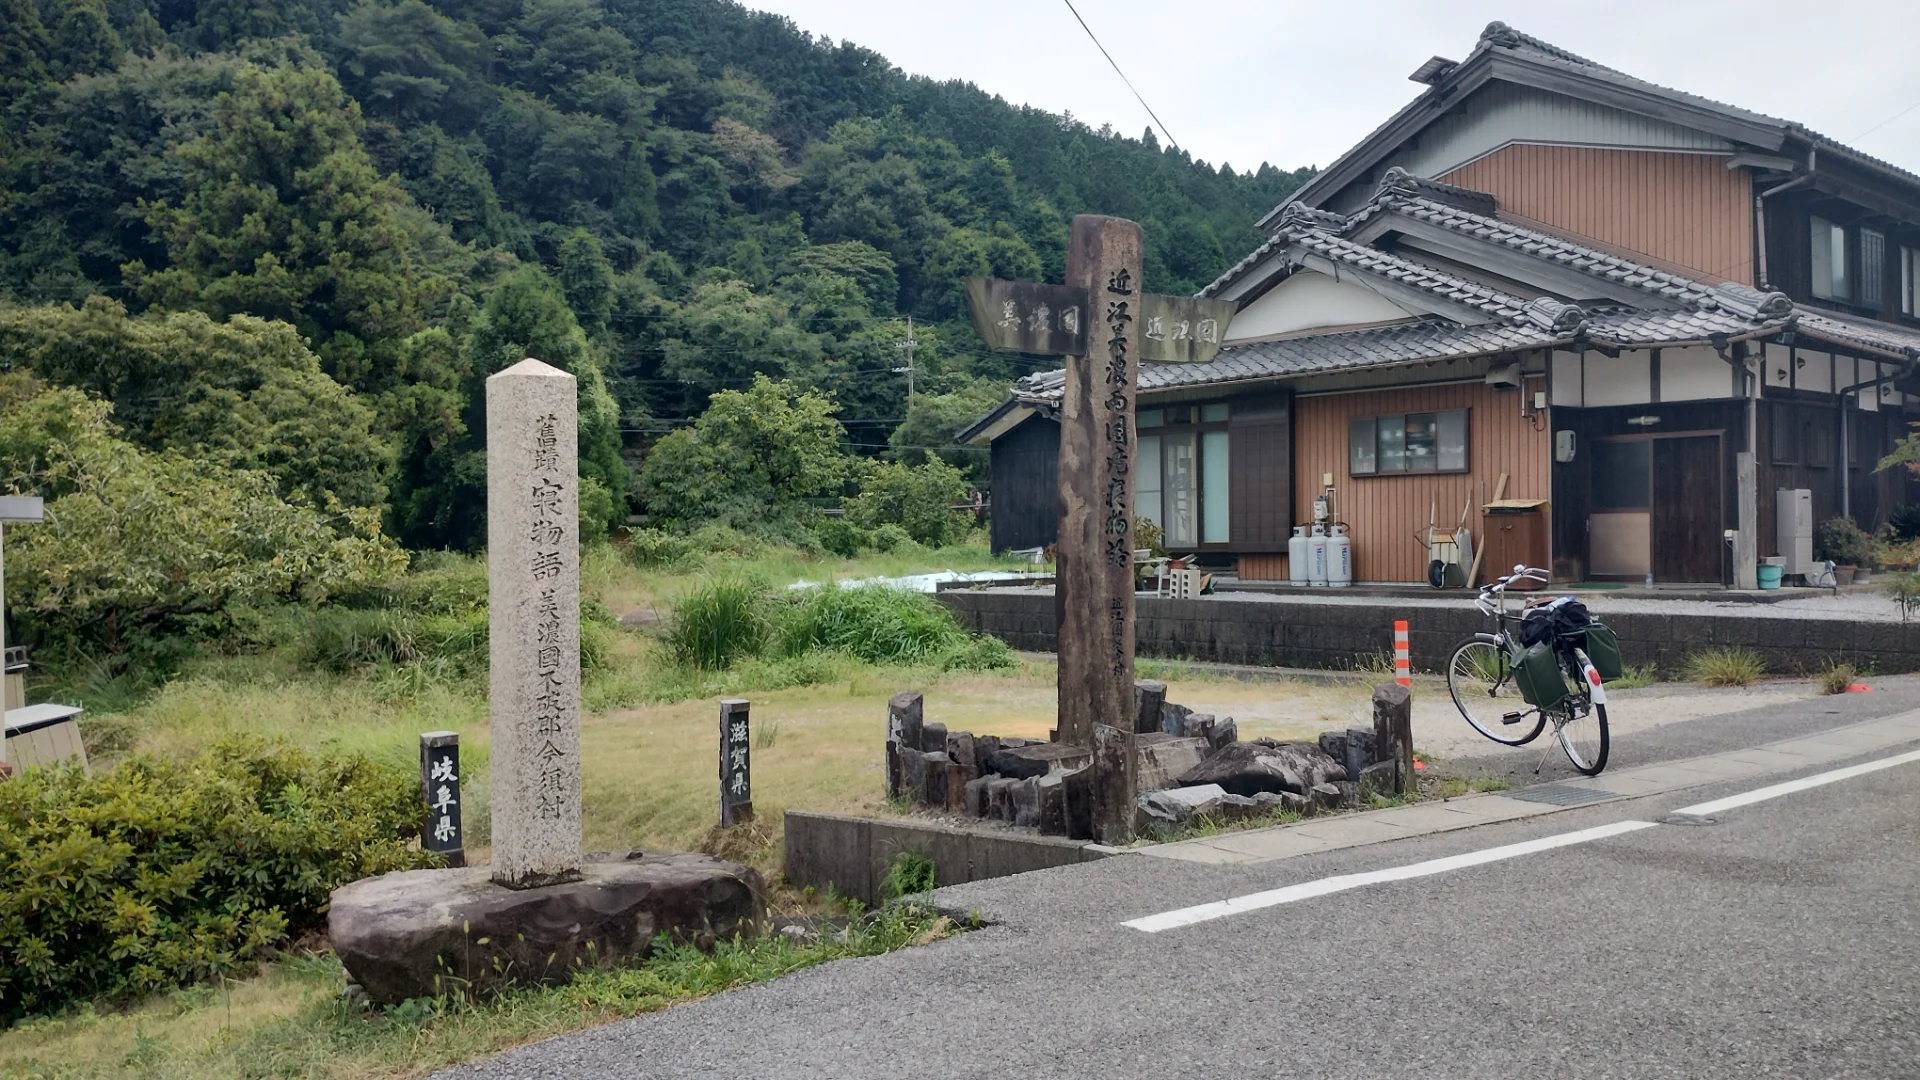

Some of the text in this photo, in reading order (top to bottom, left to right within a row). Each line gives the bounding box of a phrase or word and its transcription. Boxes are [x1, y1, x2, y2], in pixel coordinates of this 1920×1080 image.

[730, 720, 748, 795] 滋賀県
[431, 755, 458, 842] 岐阜県
